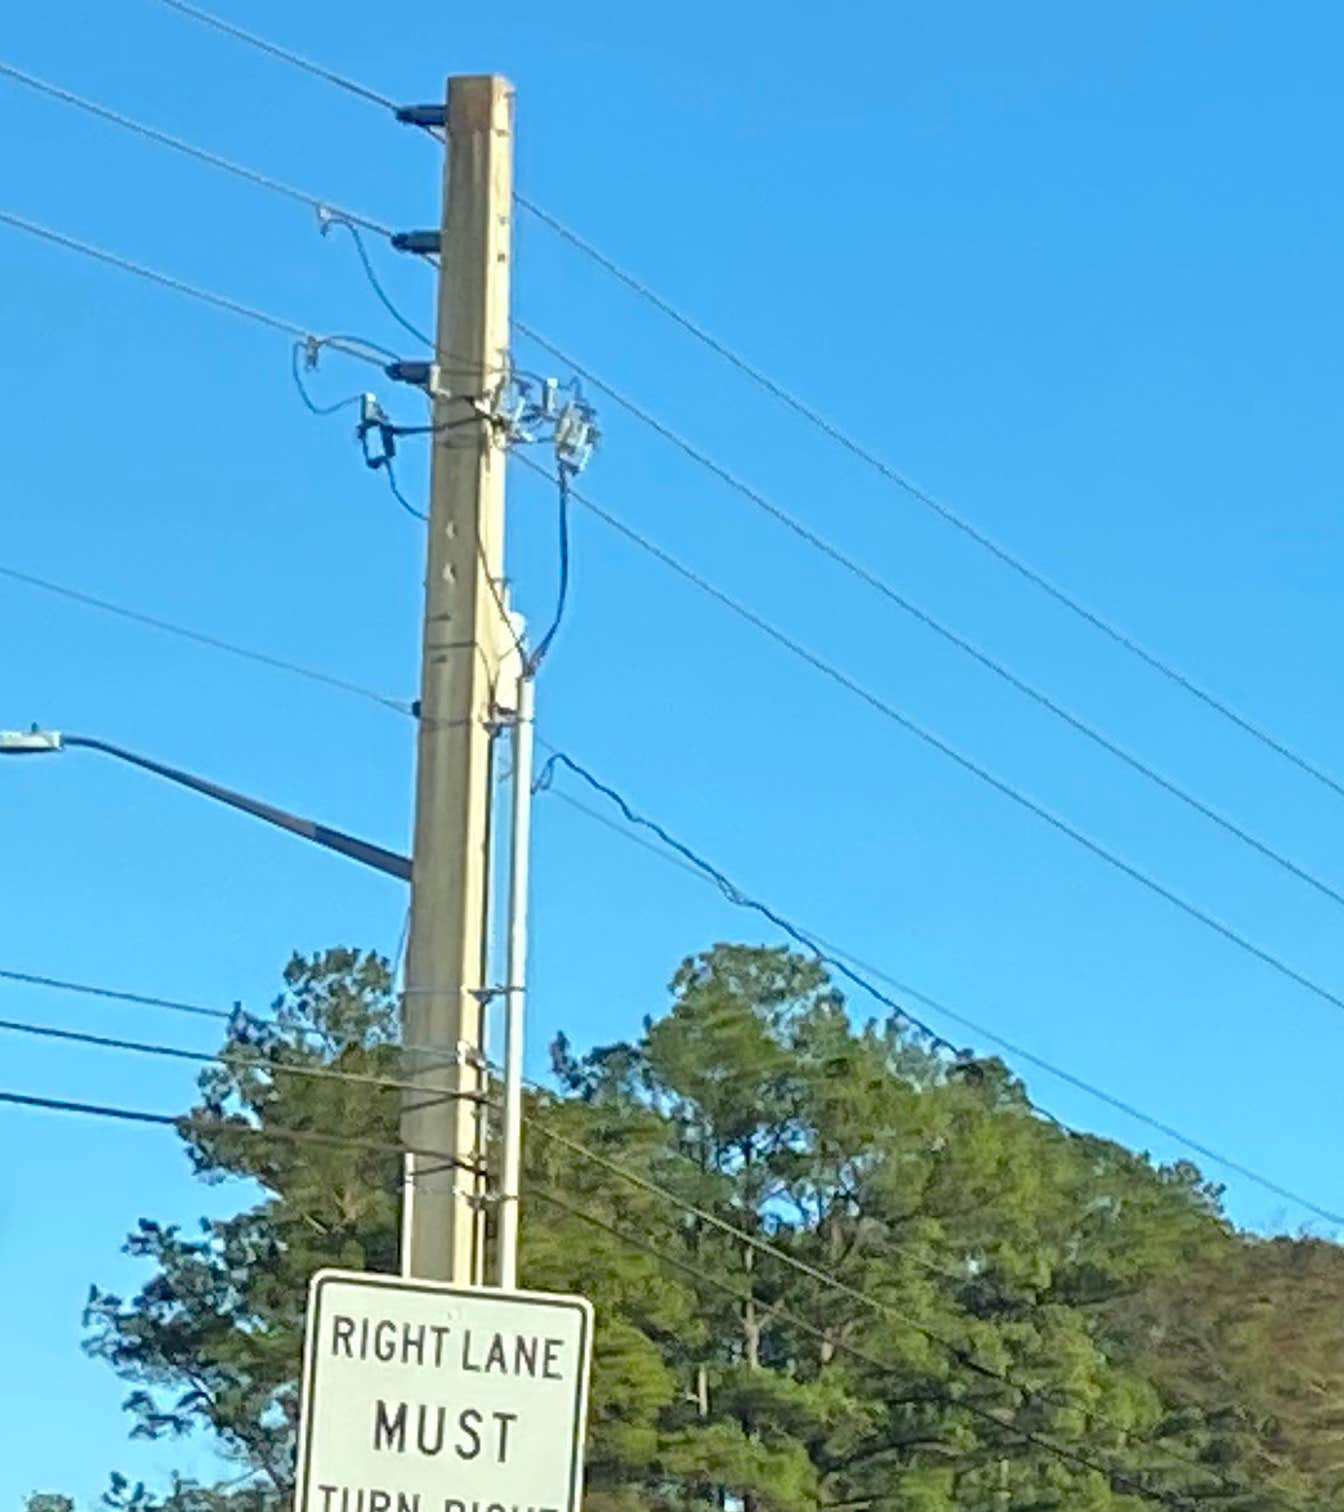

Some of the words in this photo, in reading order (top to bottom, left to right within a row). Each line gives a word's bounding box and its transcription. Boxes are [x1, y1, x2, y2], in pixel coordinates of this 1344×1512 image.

[331, 1315, 450, 1369] RIGHT
[461, 1329, 565, 1380] LANE
[372, 1399, 518, 1463] MUST
